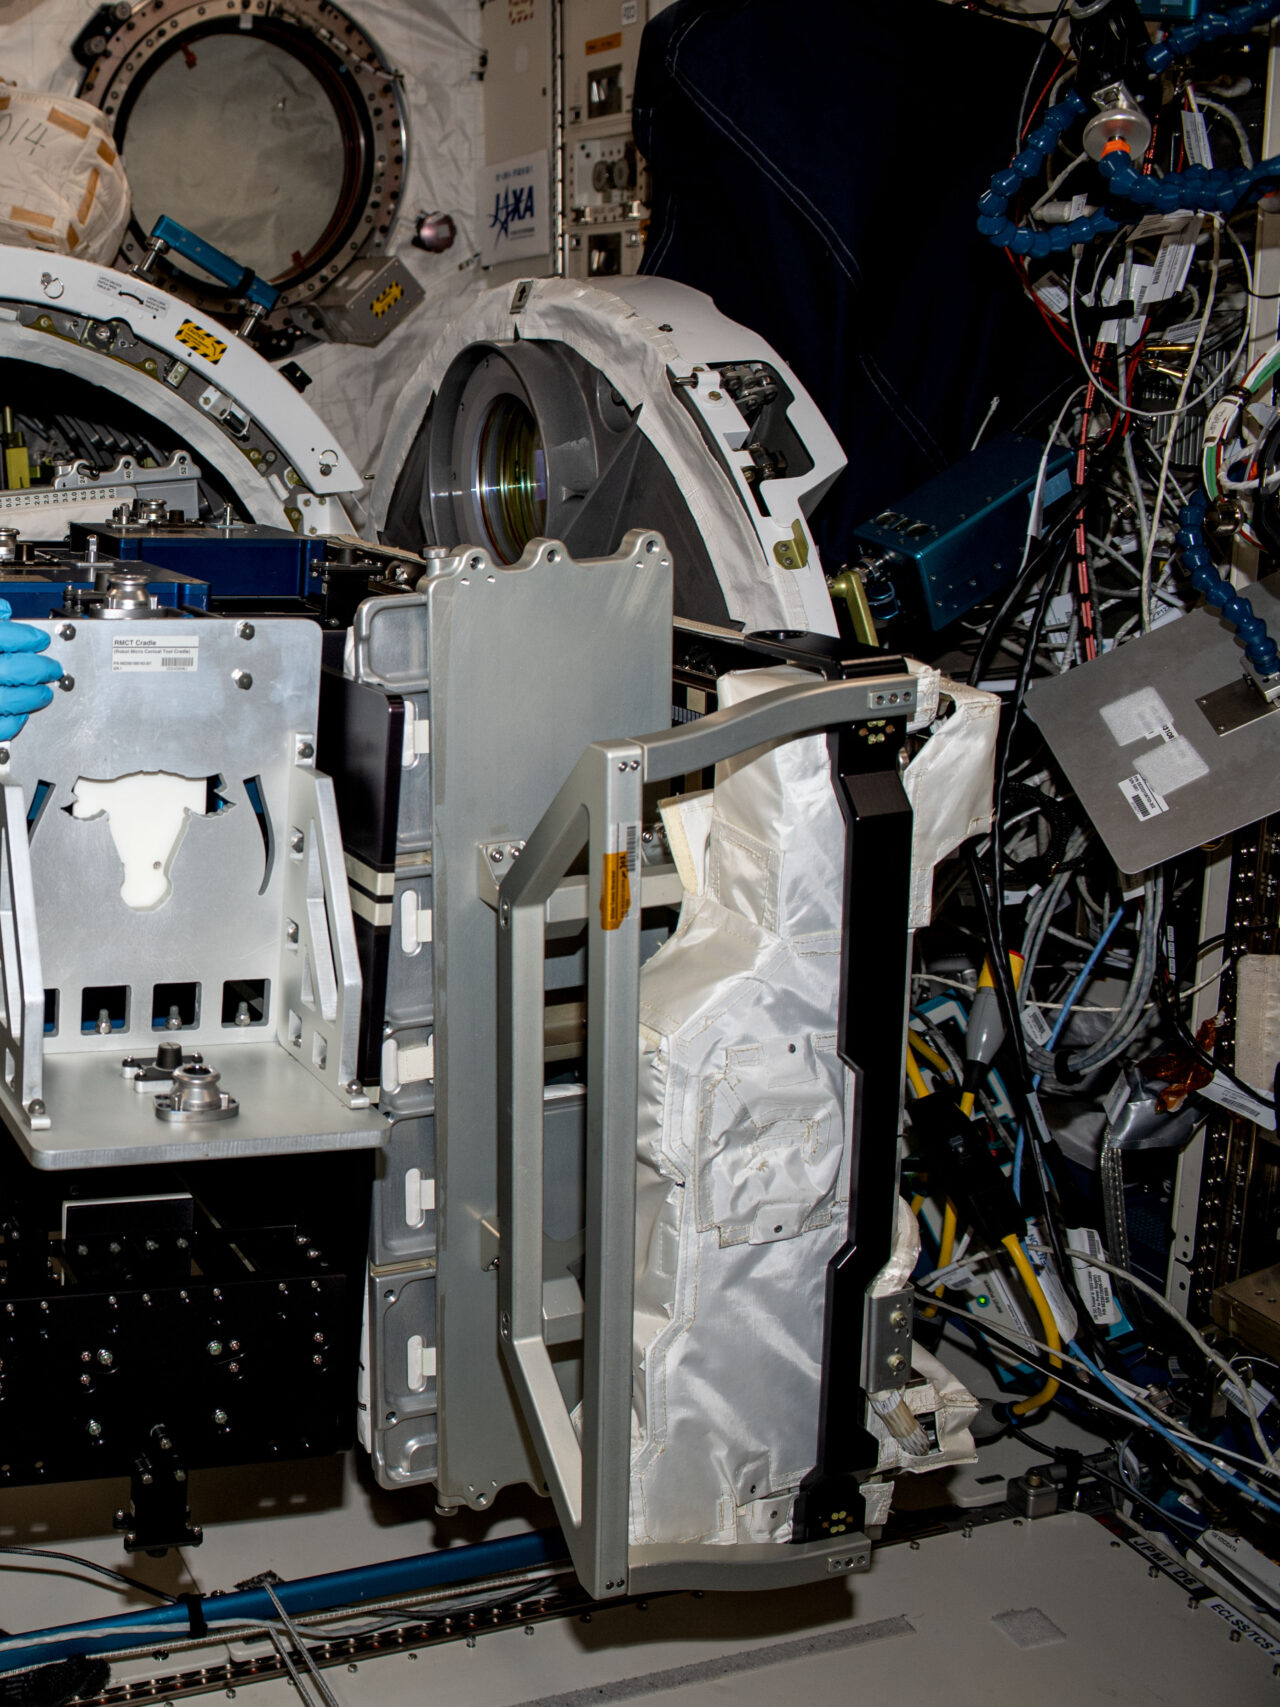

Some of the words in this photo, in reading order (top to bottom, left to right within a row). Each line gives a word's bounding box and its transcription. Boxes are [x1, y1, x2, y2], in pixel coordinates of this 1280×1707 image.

[488, 184, 535, 238] JAXA
[1133, 1539, 1174, 1567] JPM1
[1172, 1569, 1197, 1586] D6
[1210, 1603, 1274, 1650] ECLSS/TCS
